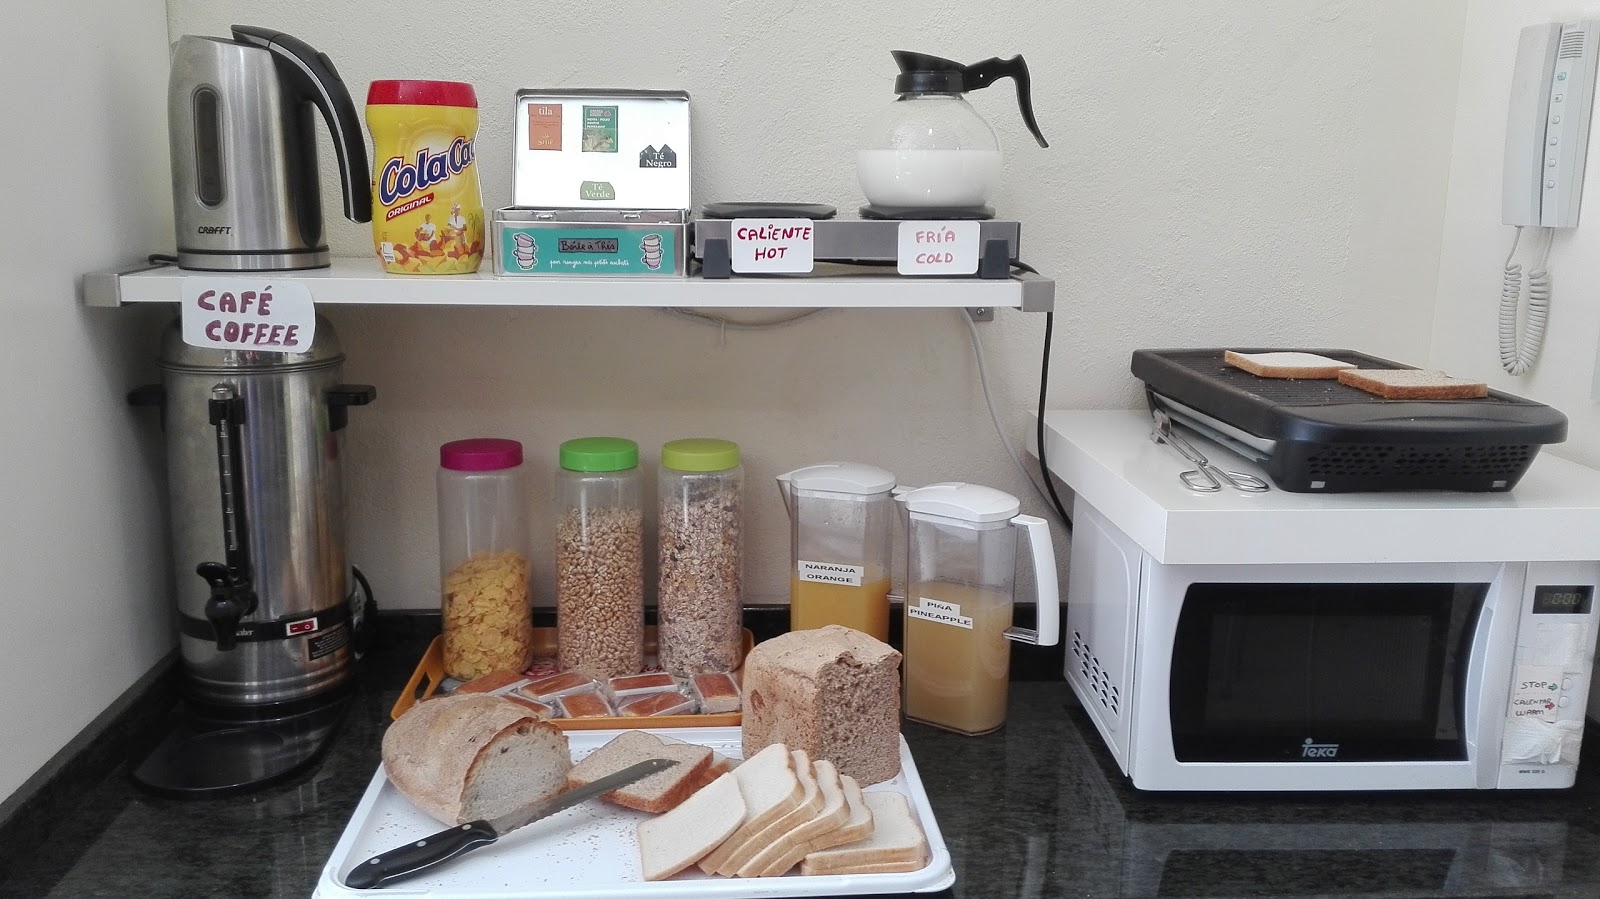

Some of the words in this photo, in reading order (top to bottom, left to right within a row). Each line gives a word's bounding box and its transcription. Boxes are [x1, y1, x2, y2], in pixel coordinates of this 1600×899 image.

[538, 106, 553, 116] tila
[652, 151, 665, 160] Té
[646, 159, 672, 168] Negro
[591, 182, 604, 190] Té
[585, 190, 610, 198] Verde
[754, 246, 788, 262] HOT
[915, 252, 954, 264] COLD
[197, 285, 273, 316] CAFÉ
[205, 319, 299, 347] COFFEE
[805, 563, 857, 574] NARANJA
[807, 573, 854, 584] ORANGE
[910, 608, 972, 626] PINEAPPLE
[1520, 681, 1548, 690] STOP
[1301, 738, 1340, 758] Teka
